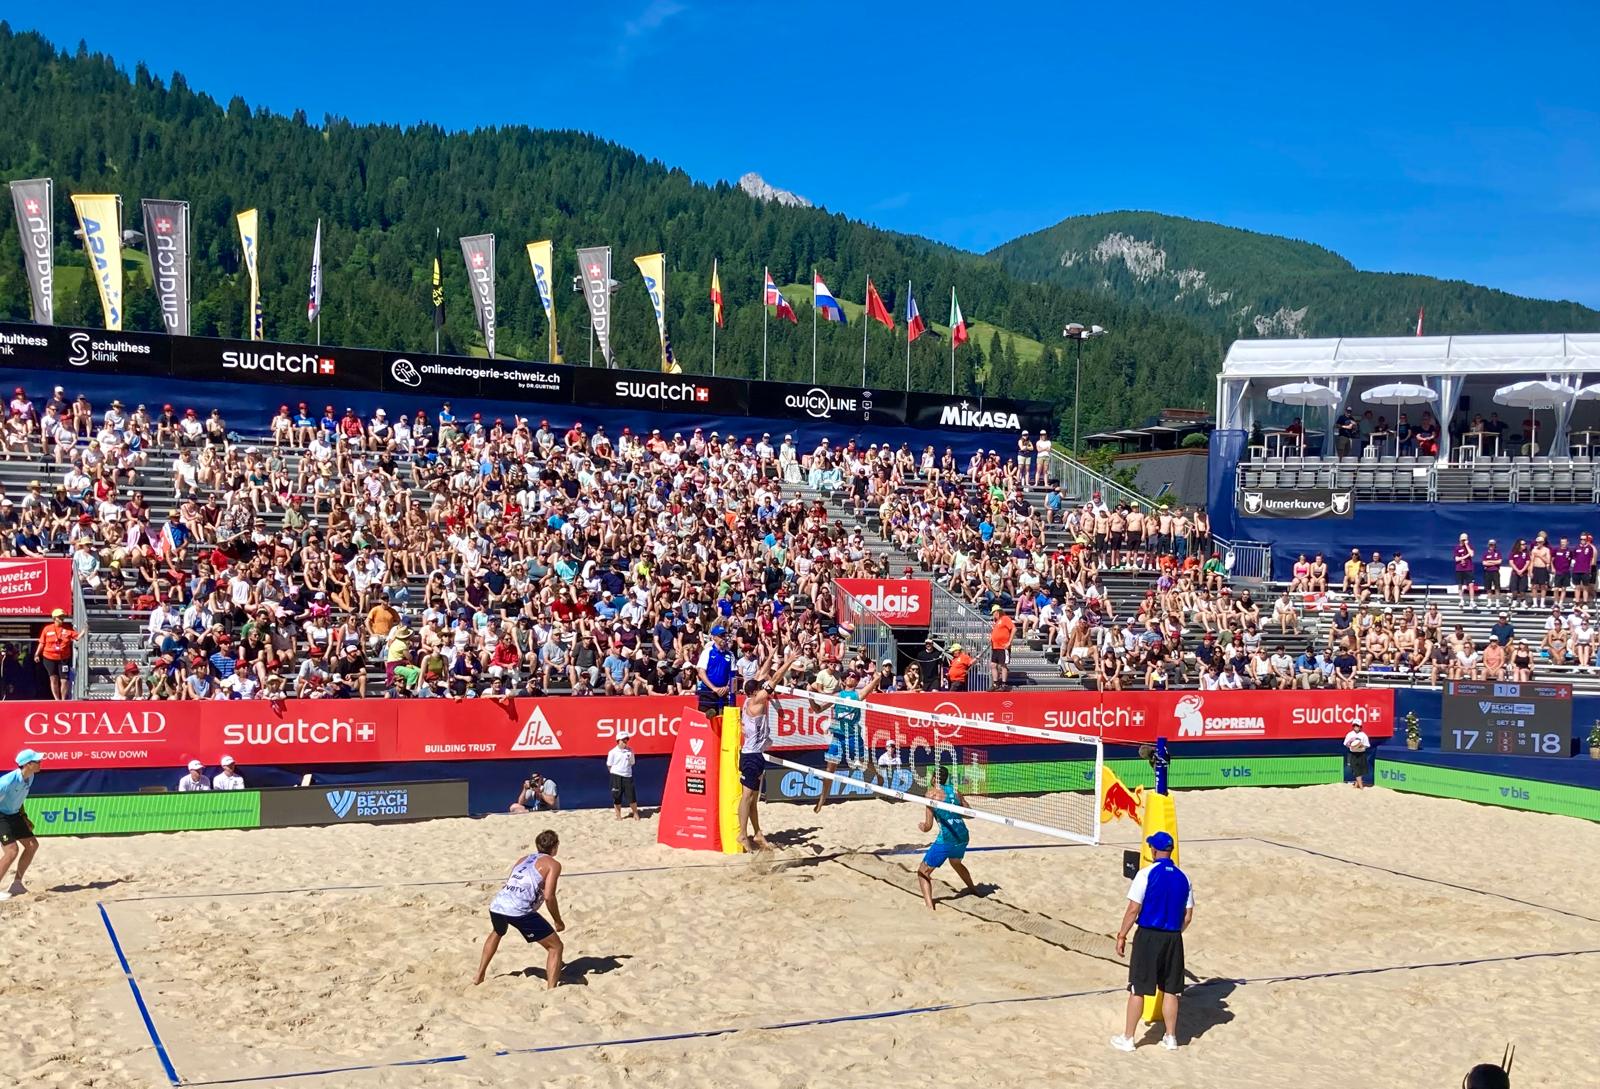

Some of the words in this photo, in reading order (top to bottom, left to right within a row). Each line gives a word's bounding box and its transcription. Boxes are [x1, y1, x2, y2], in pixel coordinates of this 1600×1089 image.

[91, 339, 151, 354] schulthess
[91, 352, 119, 362] klinik
[222, 351, 318, 374] swatch
[420, 364, 561, 384] onlinedrogerie-schweiz.ch
[615, 381, 696, 401] swatch
[1265, 499, 1325, 509] Urnerkurve
[0, 606, 43, 614] nterschied.
[1498, 686, 1503, 694] 1
[1509, 686, 1517, 695] 0
[777, 706, 833, 737] Blic
[1044, 706, 1130, 728] swatch
[1292, 704, 1368, 724] swatch
[24, 711, 166, 736] GSTAAD
[597, 713, 682, 738] swatc
[1205, 717, 1265, 729] SOPREMA
[223, 718, 352, 744] swatch
[518, 720, 553, 746] Sika
[1452, 729, 1479, 750] 17
[1531, 732, 1561, 754] 18
[71, 752, 83, 760] UP
[90, 751, 117, 759] SLOW
[119, 750, 148, 759] DOWN
[425, 744, 466, 753] BUILDING
[467, 743, 497, 753] TRUST
[1233, 766, 1252, 778] bls
[1390, 768, 1407, 782] bls
[357, 793, 408, 808] BEACH
[1511, 786, 1530, 800] bls
[63, 807, 96, 823] bls
[357, 807, 379, 816] PRO
[380, 805, 408, 815] TOUR
